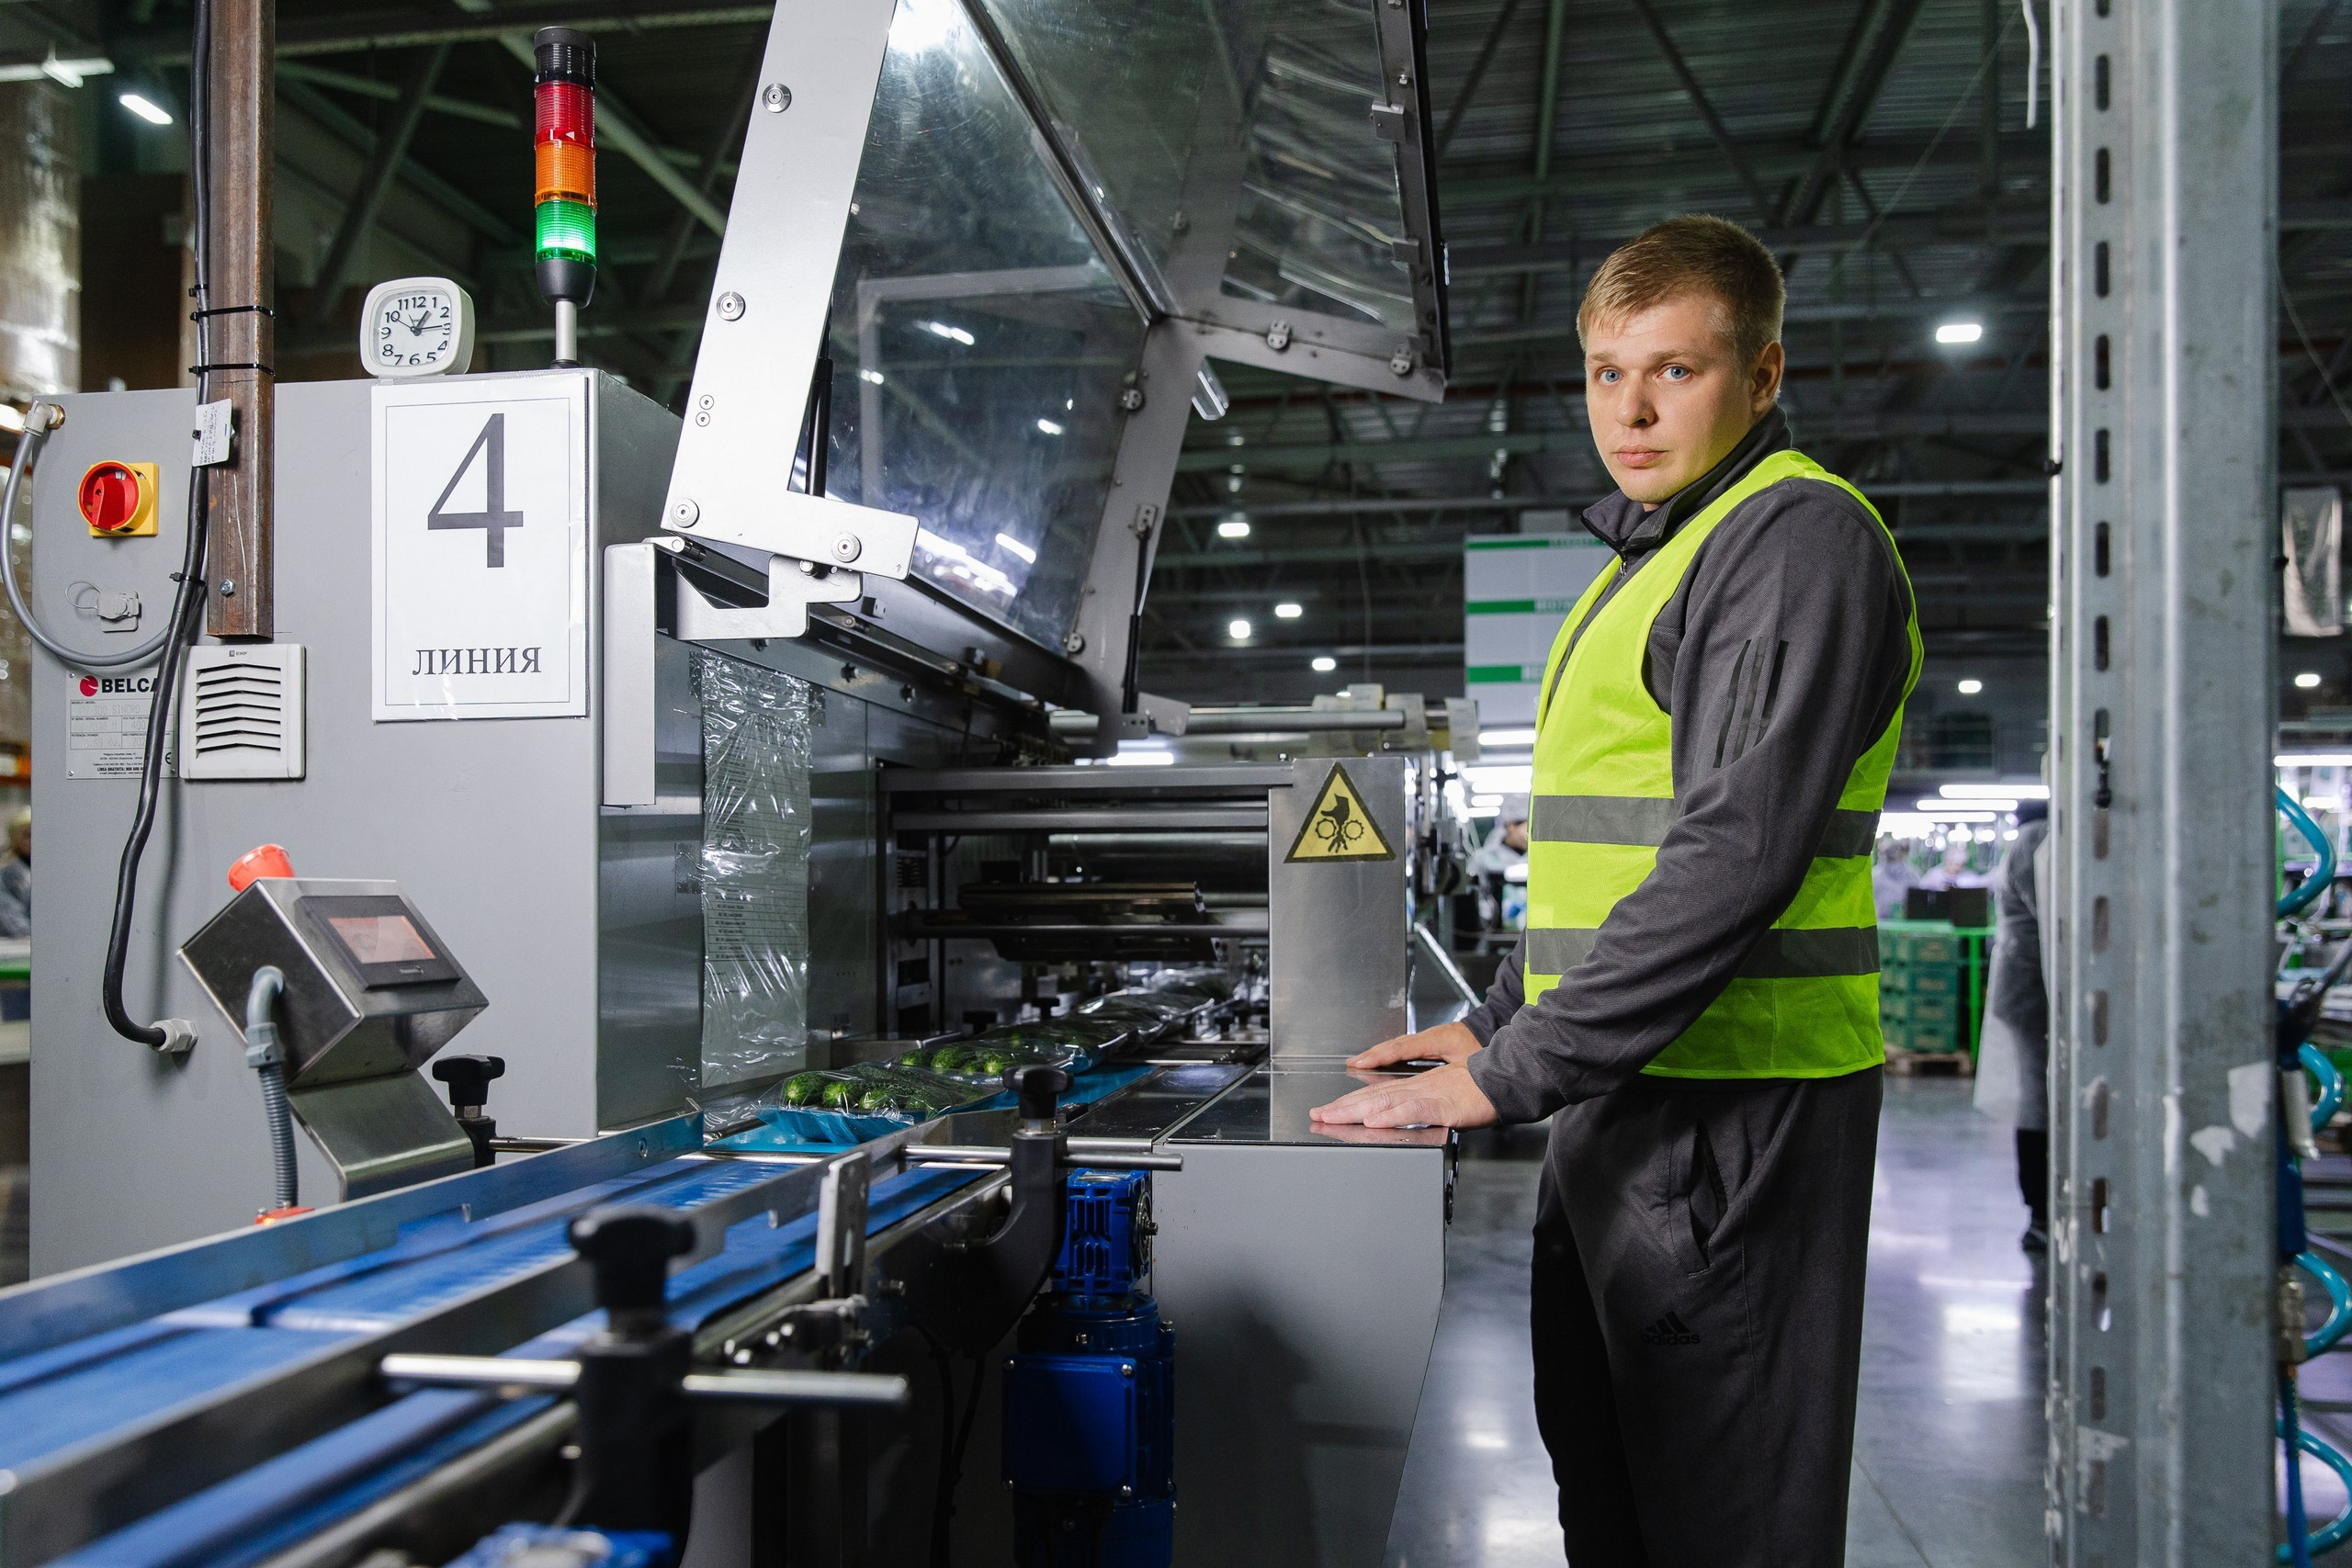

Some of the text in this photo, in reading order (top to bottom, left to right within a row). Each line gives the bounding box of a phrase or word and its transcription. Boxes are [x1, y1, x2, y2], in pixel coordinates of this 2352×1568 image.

[398, 299, 409, 310] 11
[412, 296, 426, 309] 12
[432, 297, 437, 308] 1
[385, 310, 401, 322] 10
[440, 306, 449, 318] 2
[380, 327, 391, 340] 9
[442, 323, 451, 335] 3
[382, 344, 393, 356] 8
[437, 340, 447, 351] 4
[394, 355, 403, 366] 7
[409, 354, 420, 365] 6
[426, 352, 436, 363] 5
[428, 413, 524, 568] 4
[413, 647, 542, 675] ЛИНИЯ
[1640, 1333, 1702, 1346] adidas
